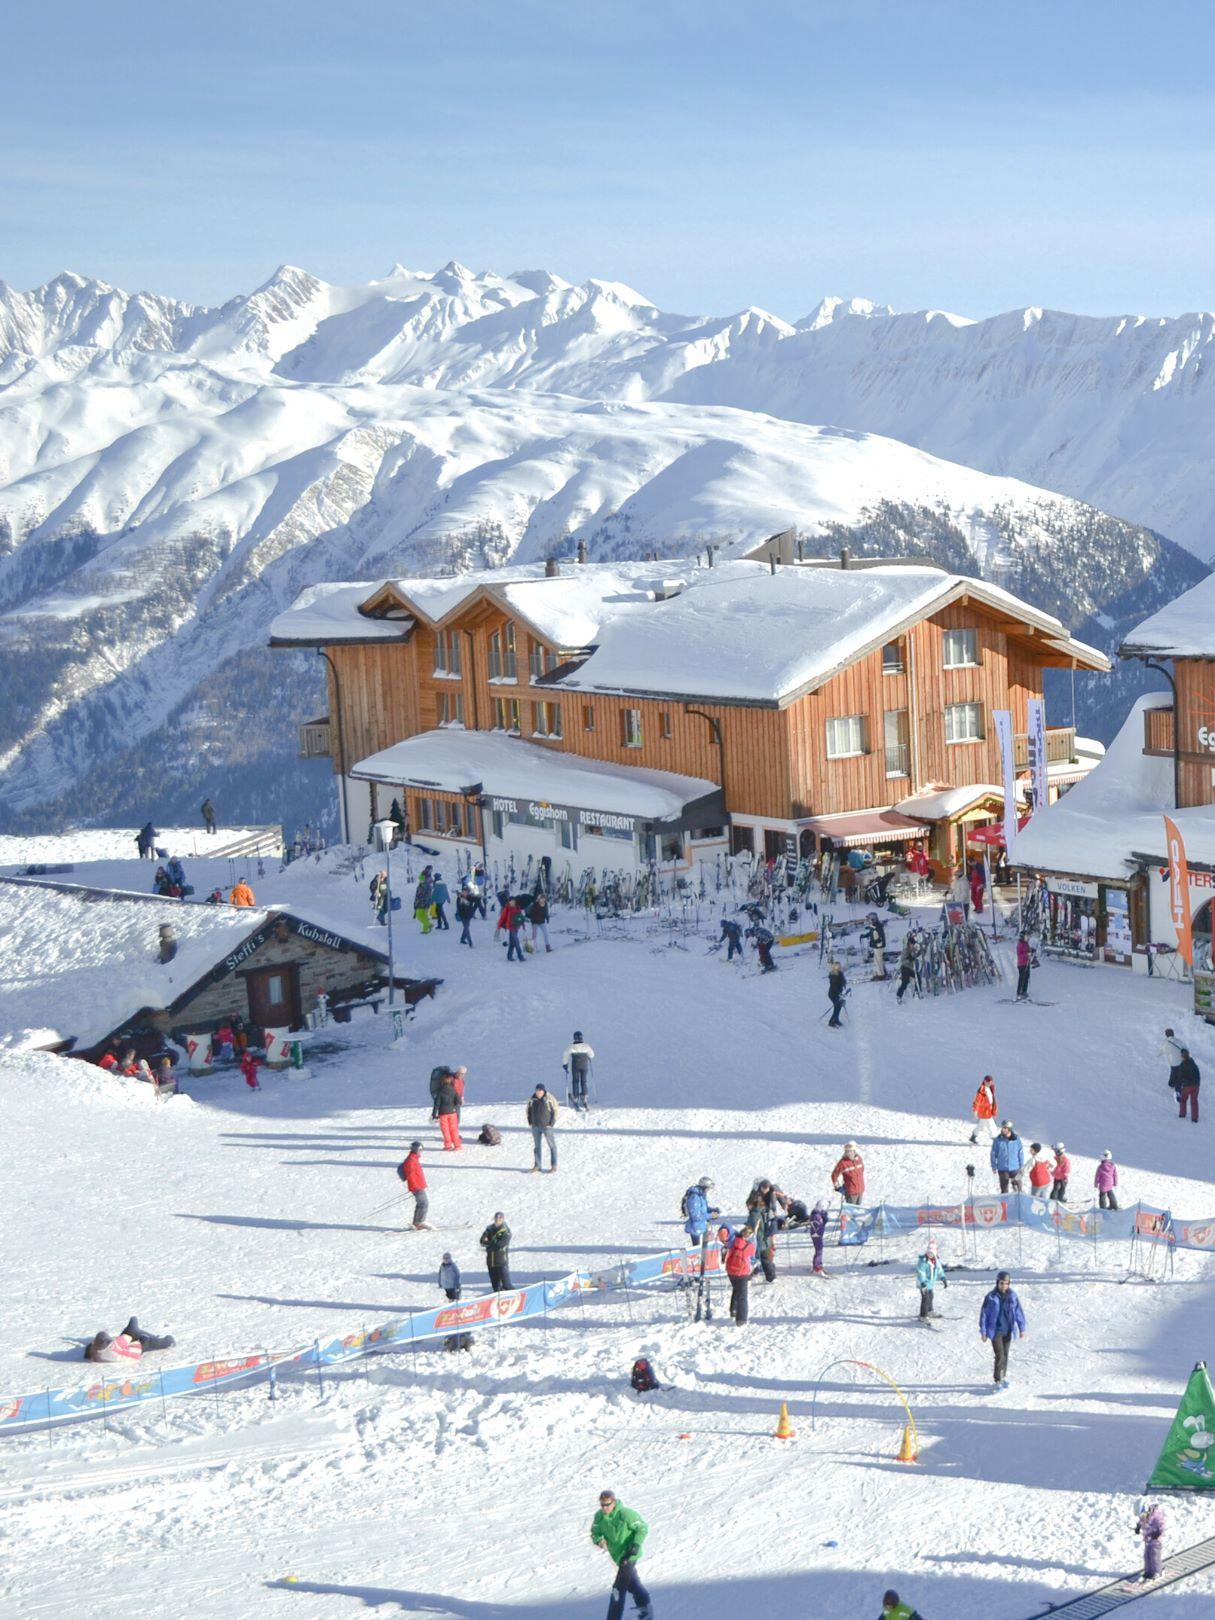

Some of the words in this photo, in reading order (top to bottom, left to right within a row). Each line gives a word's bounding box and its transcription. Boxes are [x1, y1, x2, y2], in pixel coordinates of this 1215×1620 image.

[493, 799, 518, 813] HOTEL
[528, 803, 568, 821] Eggishorn
[580, 811, 635, 831] RESTAURANT
[1057, 883, 1087, 894] VOLKEN
[297, 923, 341, 949] Kuhstall
